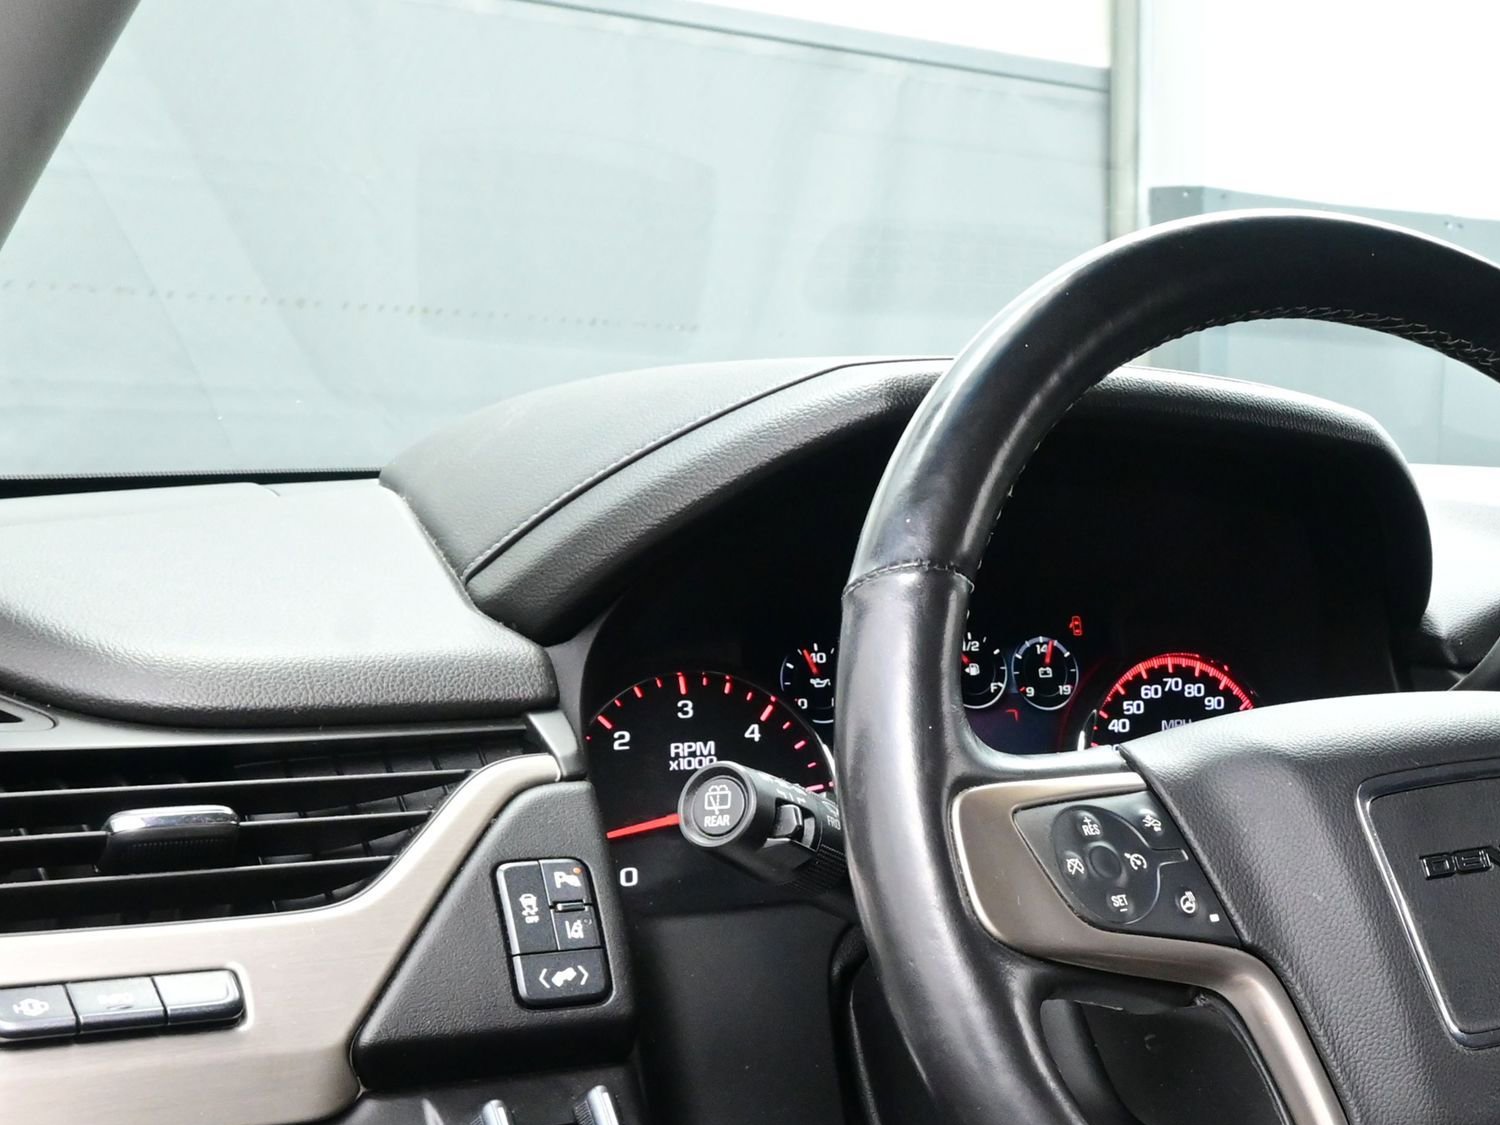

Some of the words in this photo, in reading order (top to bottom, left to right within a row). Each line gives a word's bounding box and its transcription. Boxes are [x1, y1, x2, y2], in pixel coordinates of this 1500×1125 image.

[1025, 686, 1035, 698] 9
[1058, 685, 1071, 695] 19
[1141, 684, 1162, 699] 60
[1163, 677, 1183, 692] 70
[1184, 683, 1204, 699] 80
[677, 700, 694, 719] 3
[1123, 701, 1144, 715] 50
[1204, 697, 1225, 710] 90
[744, 723, 761, 742] 4
[1107, 719, 1130, 734] 40
[612, 731, 631, 750] 2
[670, 741, 715, 757] RPM
[704, 815, 730, 827] REAR
[1081, 824, 1101, 836] RES
[620, 867, 638, 887] 0
[1111, 894, 1129, 907] SET
